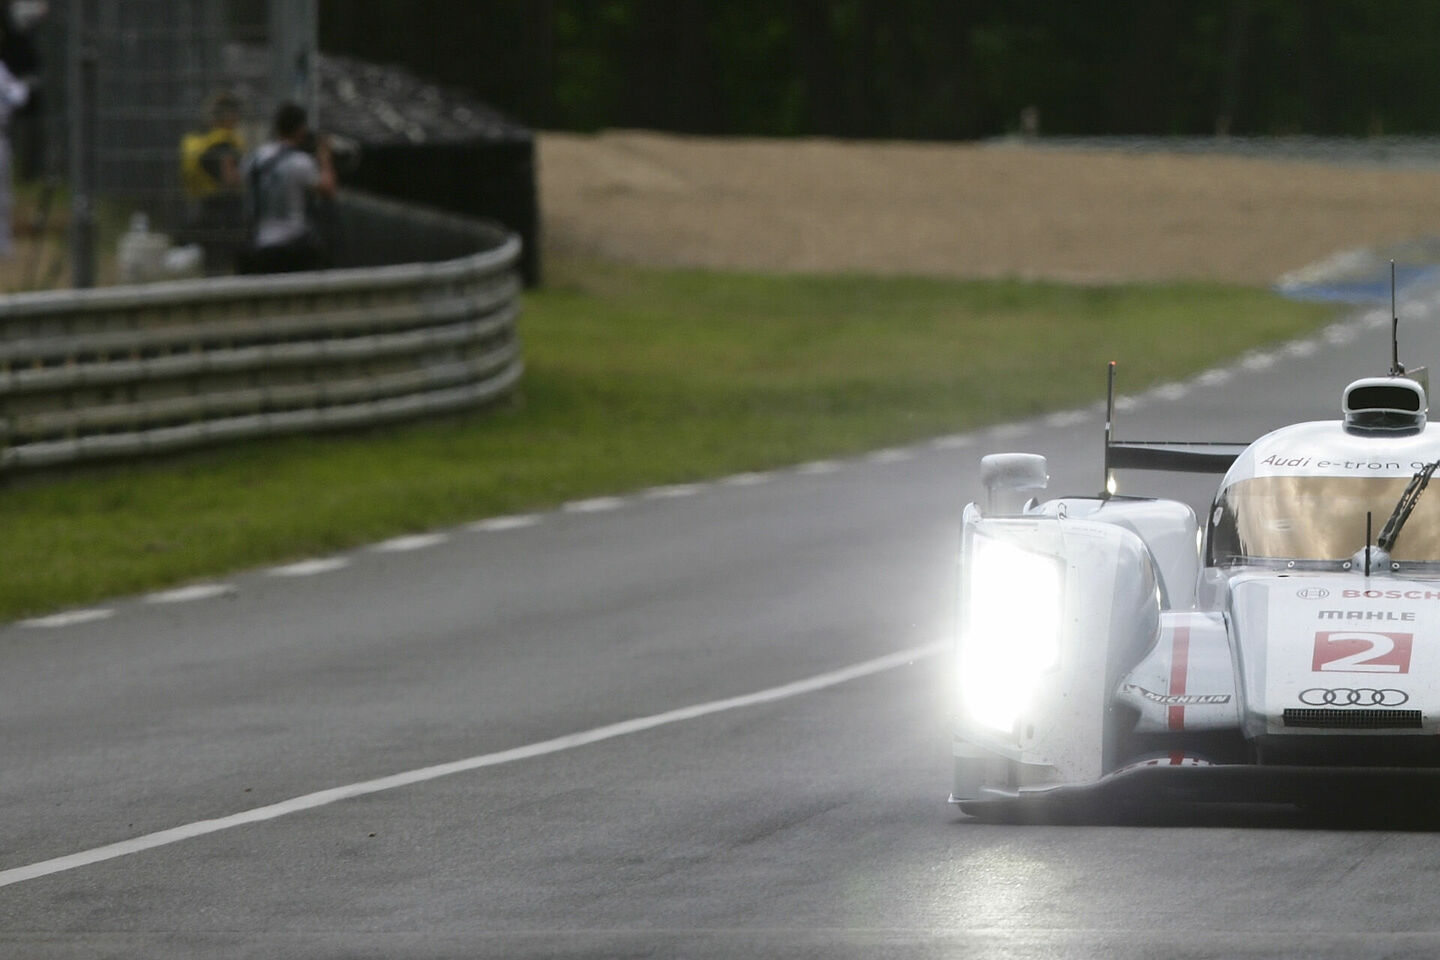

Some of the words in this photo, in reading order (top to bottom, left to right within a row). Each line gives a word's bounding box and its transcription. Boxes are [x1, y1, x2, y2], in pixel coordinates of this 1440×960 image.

[1260, 454, 1312, 467] Audi
[1317, 460, 1400, 470] e-tron
[1318, 610, 1416, 621] MAHLE
[1320, 632, 1401, 673] 2
[1144, 692, 1228, 704] MICHELIN
